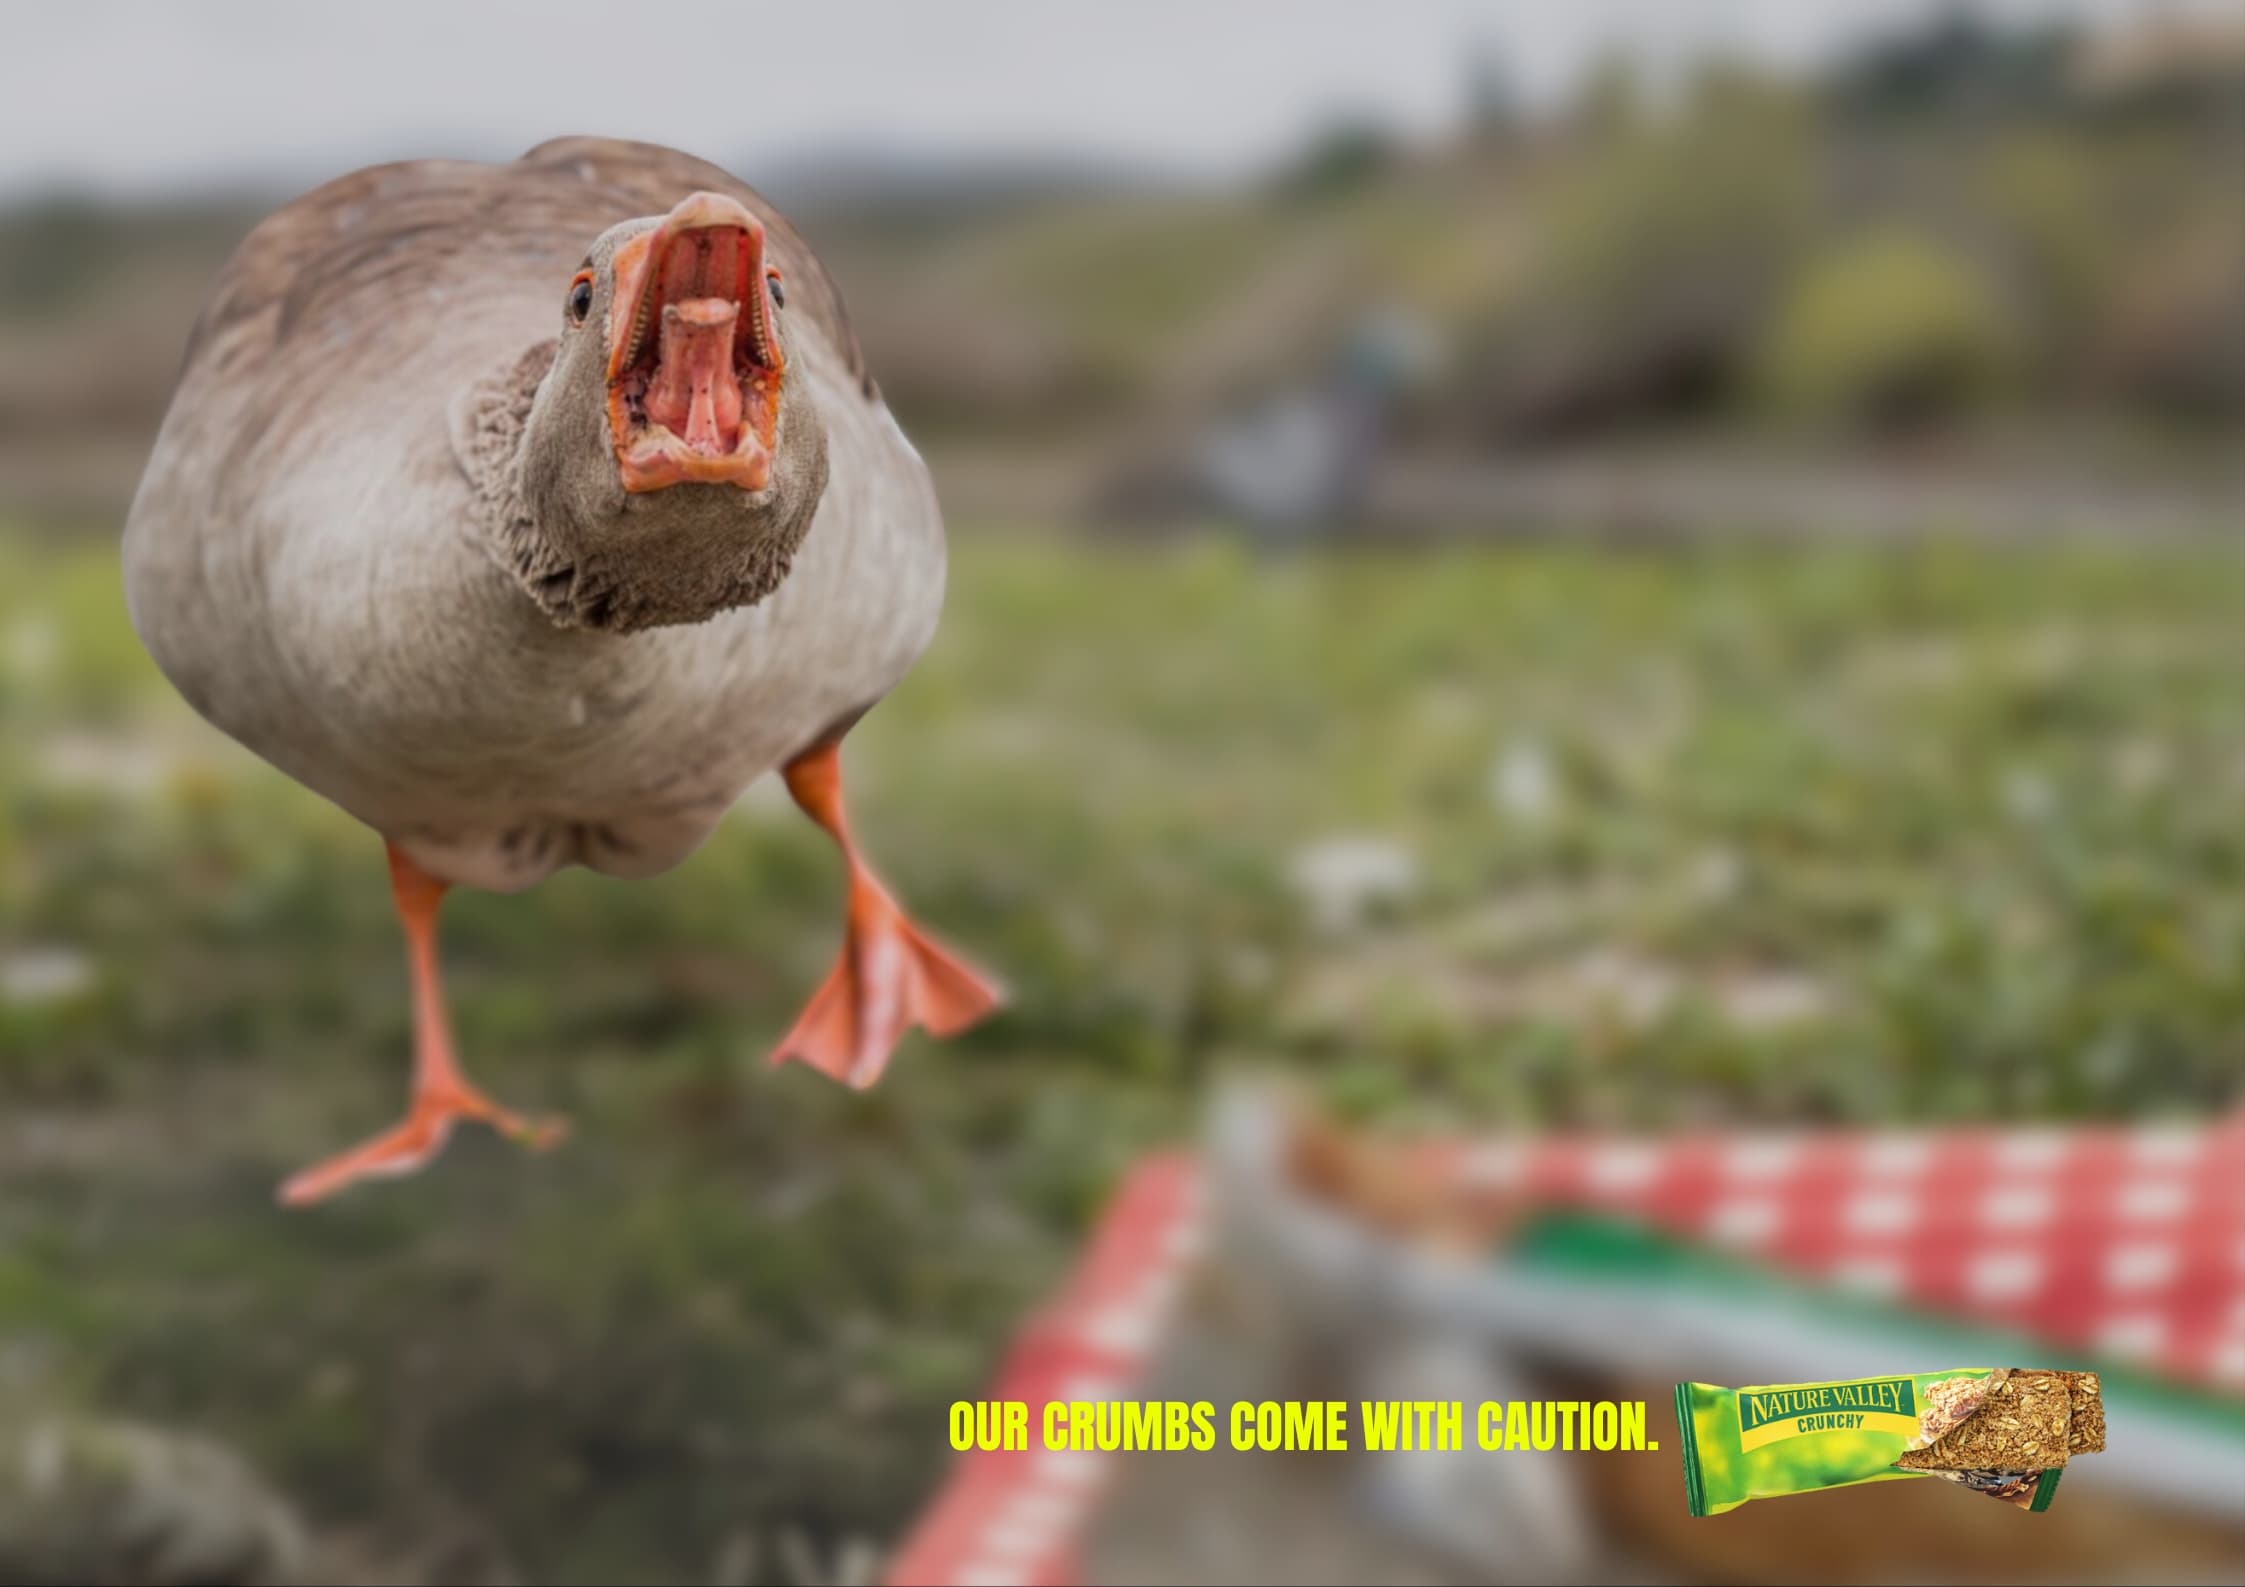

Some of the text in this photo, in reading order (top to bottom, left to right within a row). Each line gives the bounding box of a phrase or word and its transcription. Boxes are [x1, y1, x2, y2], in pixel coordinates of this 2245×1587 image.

[1750, 1382, 1903, 1425] NATURE VALLEY
[1797, 1414, 1864, 1433] CRUNCHY
